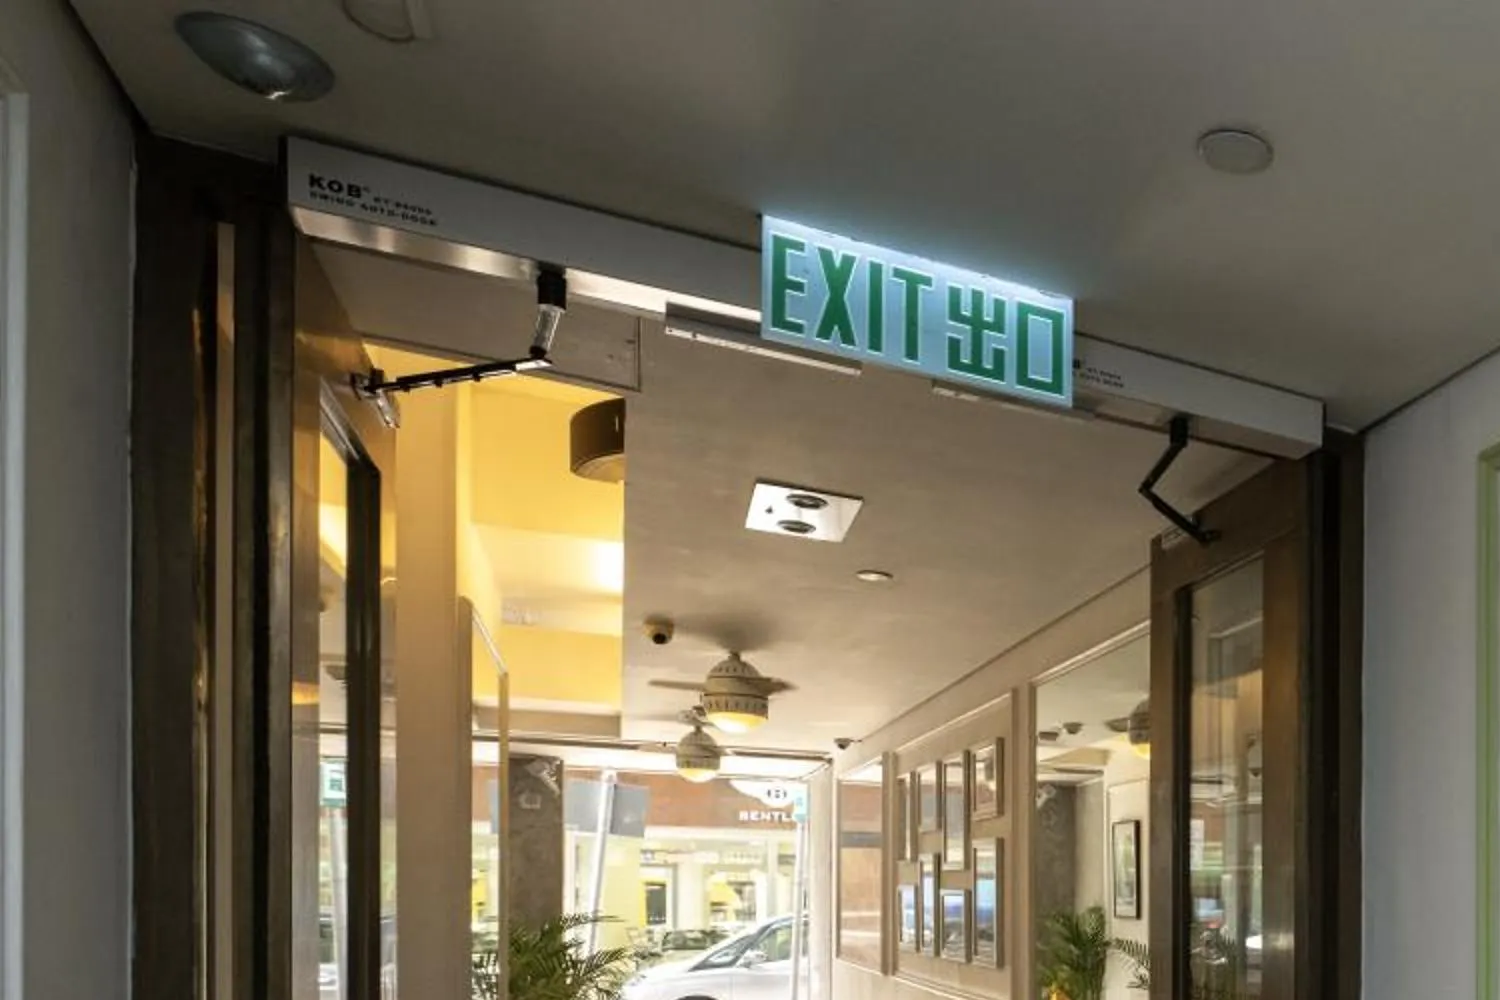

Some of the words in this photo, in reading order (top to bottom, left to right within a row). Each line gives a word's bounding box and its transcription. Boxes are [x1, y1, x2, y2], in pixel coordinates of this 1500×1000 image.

[308, 173, 362, 199] KOB
[771, 234, 933, 361] EXIT
[947, 285, 1065, 396] 出口
[738, 810, 794, 822] BENTL
